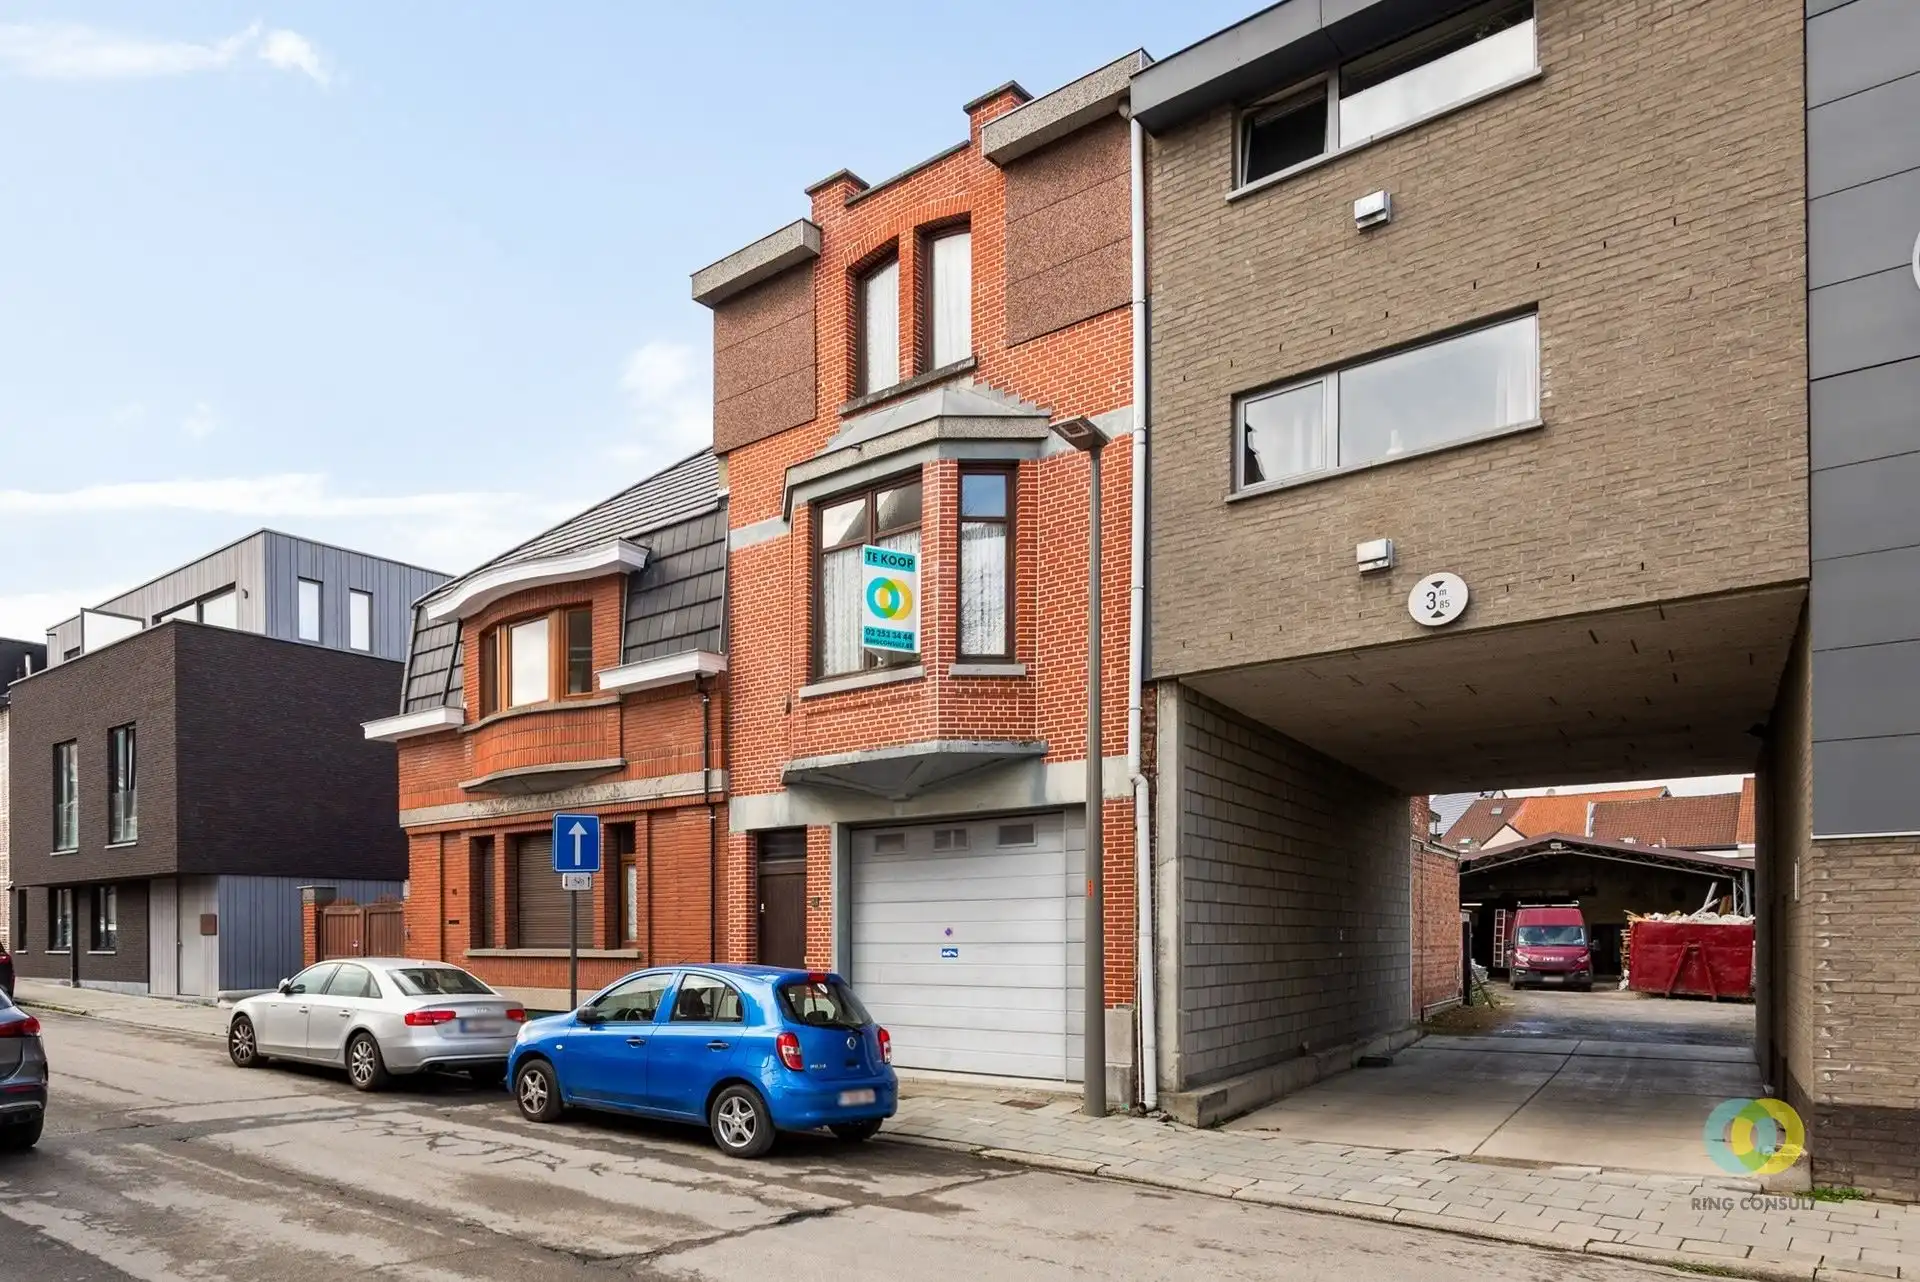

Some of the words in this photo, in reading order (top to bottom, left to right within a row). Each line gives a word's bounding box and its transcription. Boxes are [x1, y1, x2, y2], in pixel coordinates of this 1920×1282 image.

[867, 551, 877, 562] TE
[881, 554, 914, 568] KOOP
[1426, 591, 1436, 610] 3
[1440, 599, 1450, 608] 85
[866, 627, 875, 636] 02
